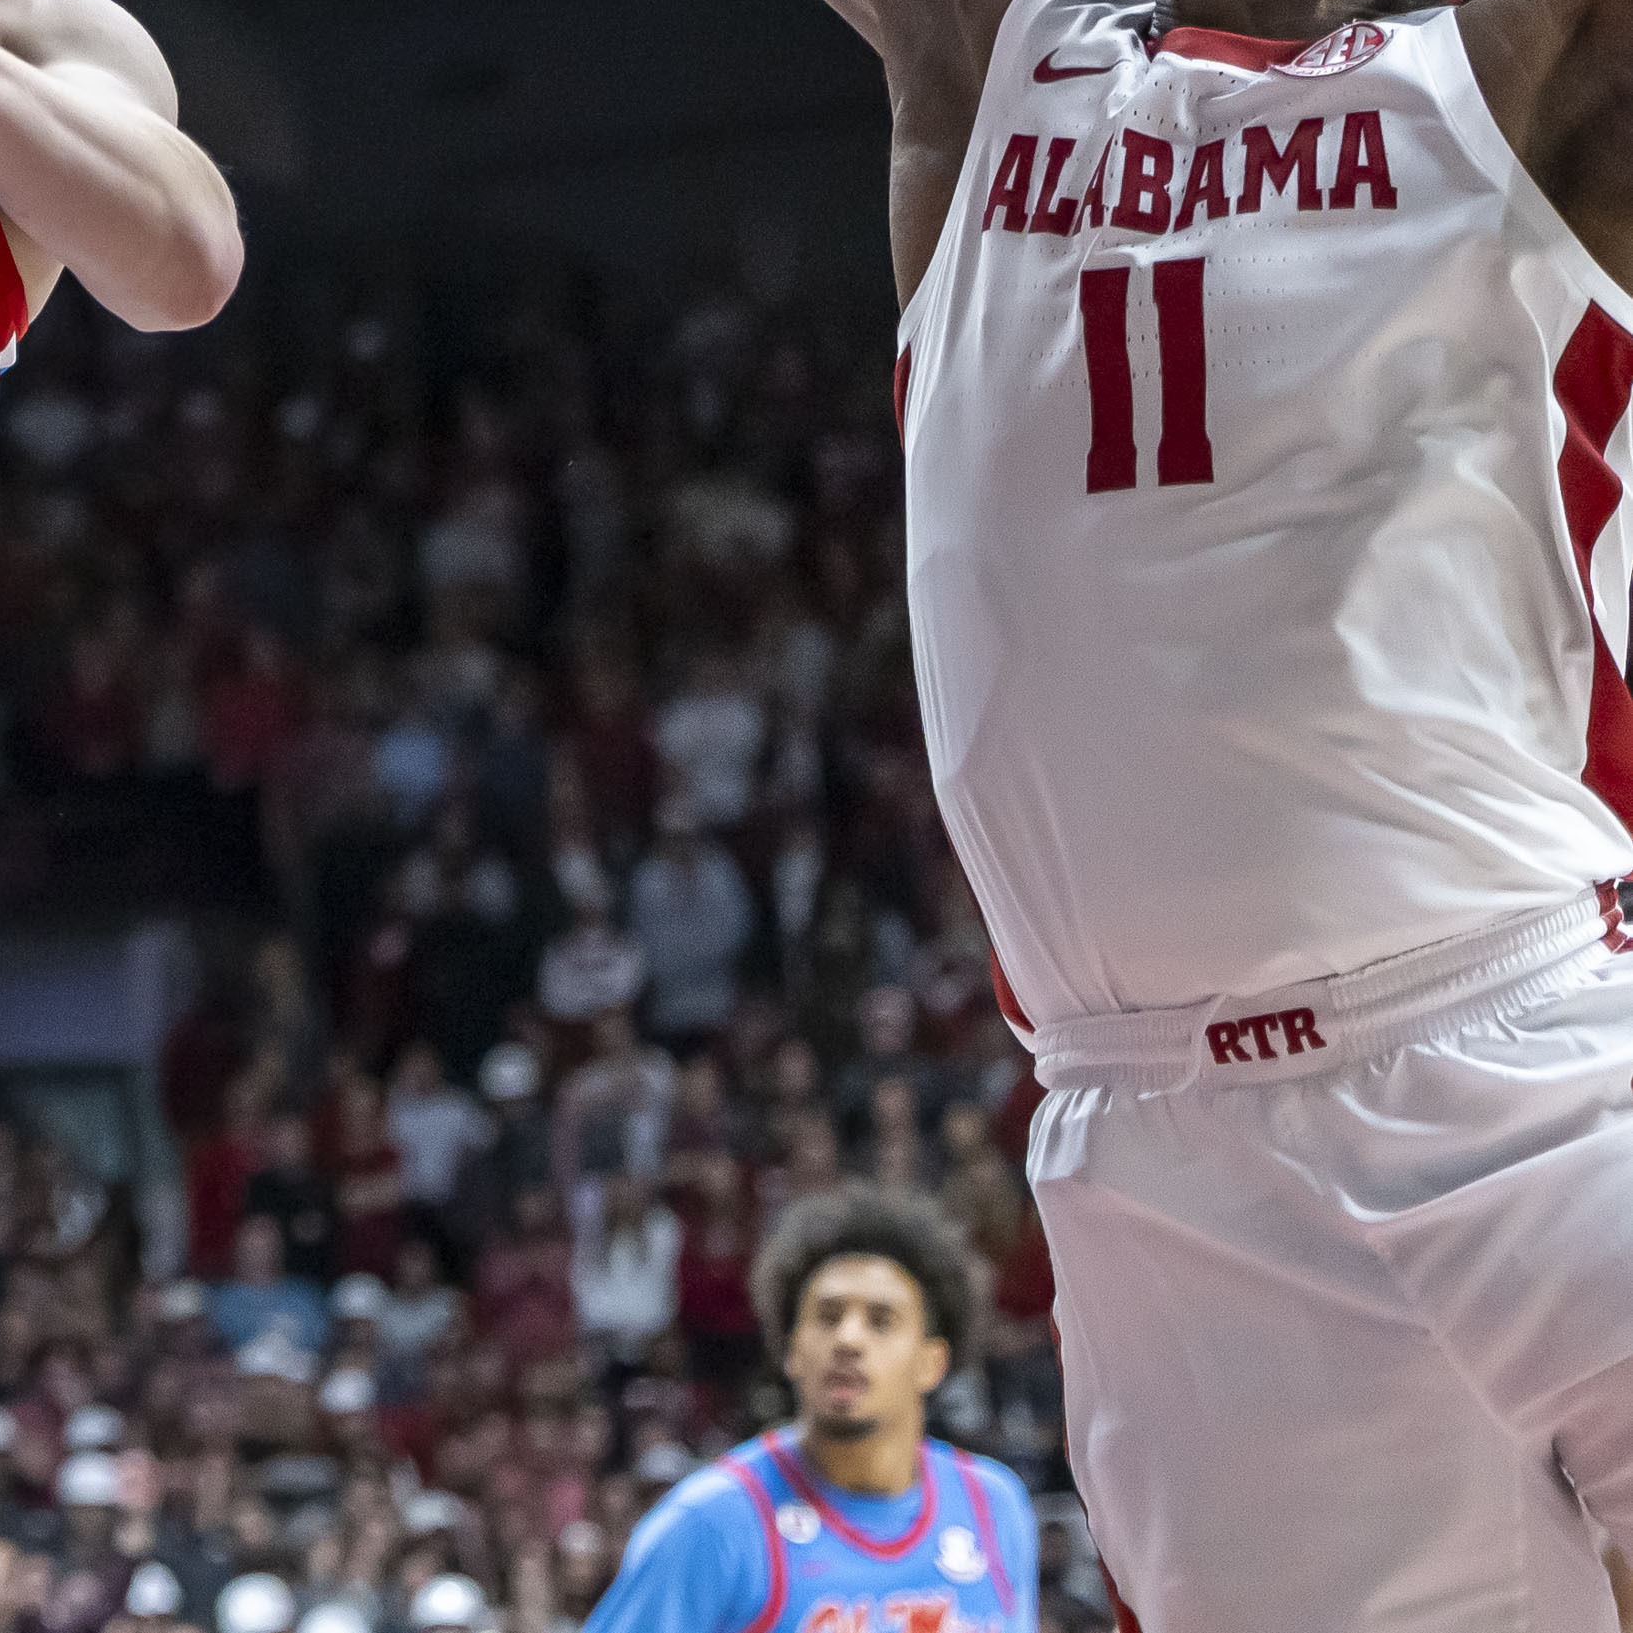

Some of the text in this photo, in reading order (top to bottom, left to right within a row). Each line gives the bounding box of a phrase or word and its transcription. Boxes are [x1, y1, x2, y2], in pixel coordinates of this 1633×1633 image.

[1296, 25, 1378, 67] SEC
[982, 110, 1399, 236] ALABAMA
[1079, 257, 1215, 494] 11
[1204, 1006, 1328, 1066] RTR
